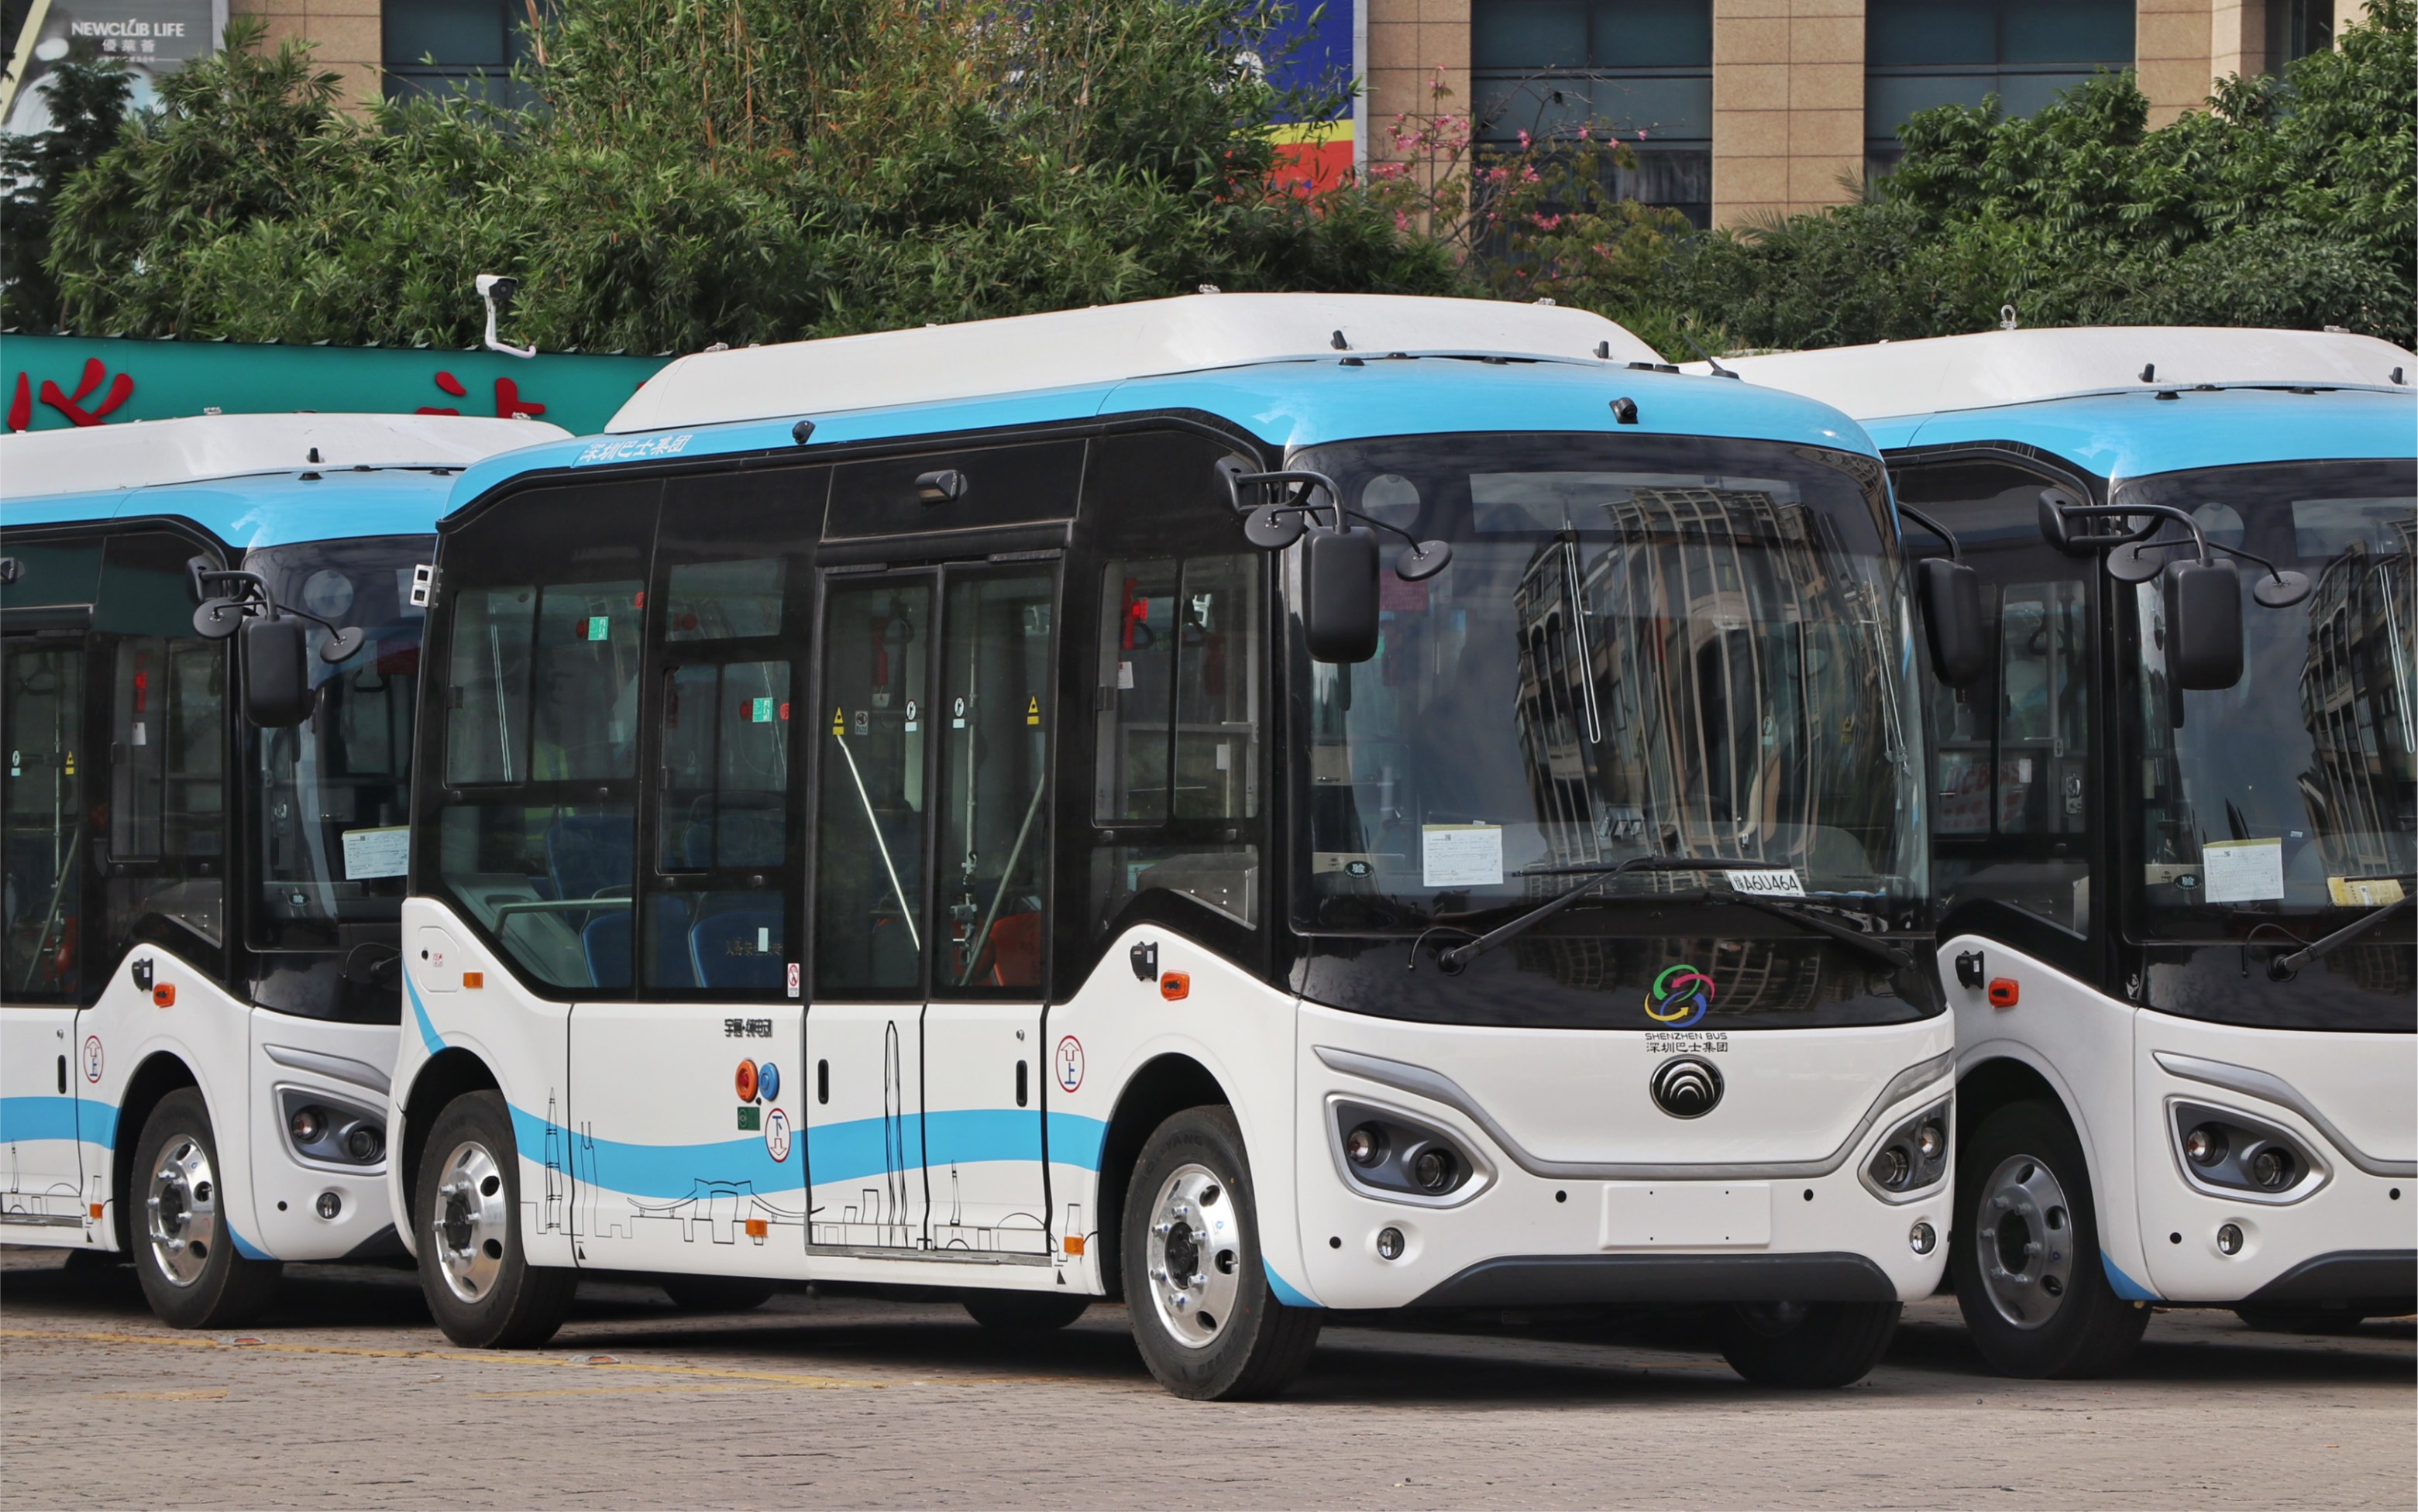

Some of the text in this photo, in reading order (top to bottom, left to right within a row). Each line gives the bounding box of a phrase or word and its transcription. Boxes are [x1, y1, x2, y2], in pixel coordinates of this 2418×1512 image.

[71, 19, 185, 37] NEWCLUB LIFE
[580, 434, 694, 463] 深圳巴士集团
[1645, 1033, 1703, 1041] SHENZHEN
[1646, 1041, 1728, 1053] 深圳巴士集团
[89, 1057, 98, 1077] 上
[1064, 1062, 1077, 1085] 上
[772, 1115, 783, 1137] 下
